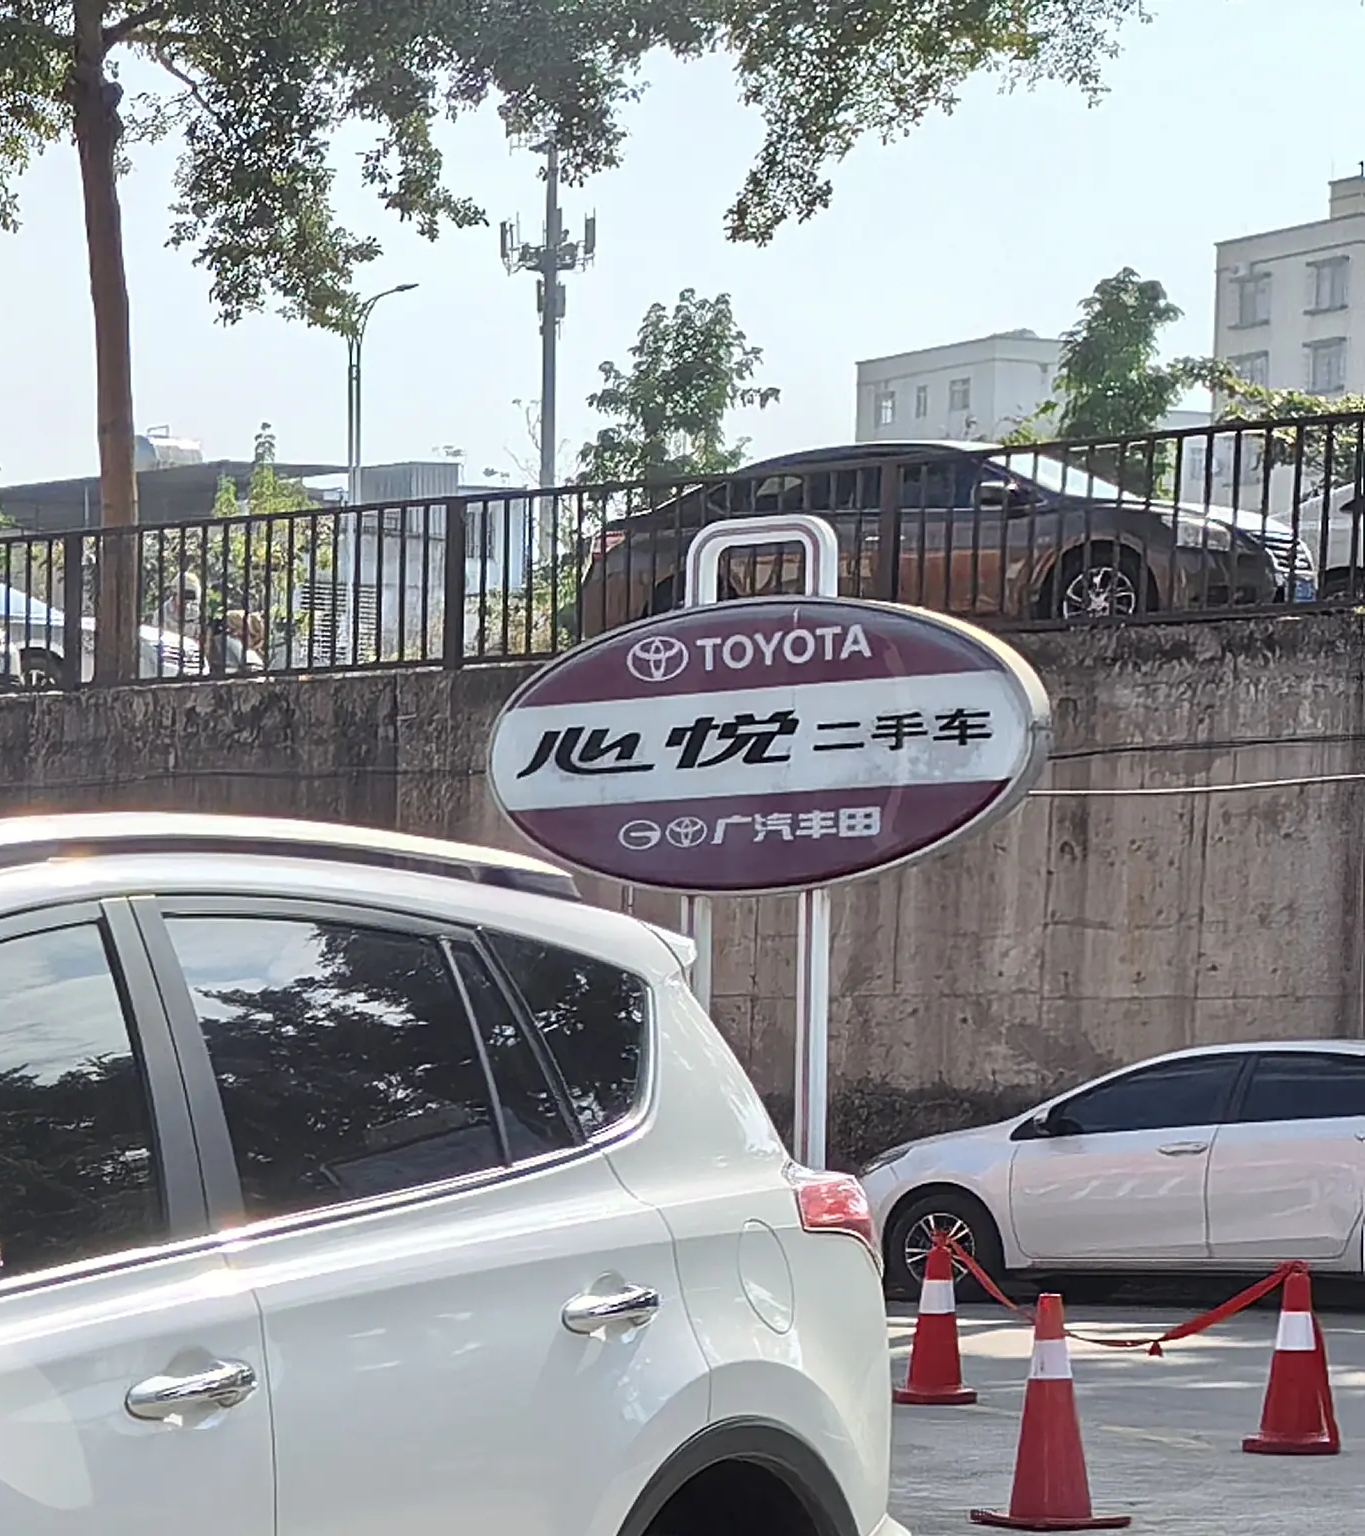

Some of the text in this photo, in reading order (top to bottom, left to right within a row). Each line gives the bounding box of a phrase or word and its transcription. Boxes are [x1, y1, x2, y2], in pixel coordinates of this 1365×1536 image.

[697, 624, 873, 671] TOYOTA
[710, 806, 882, 846] 广汽丰田
